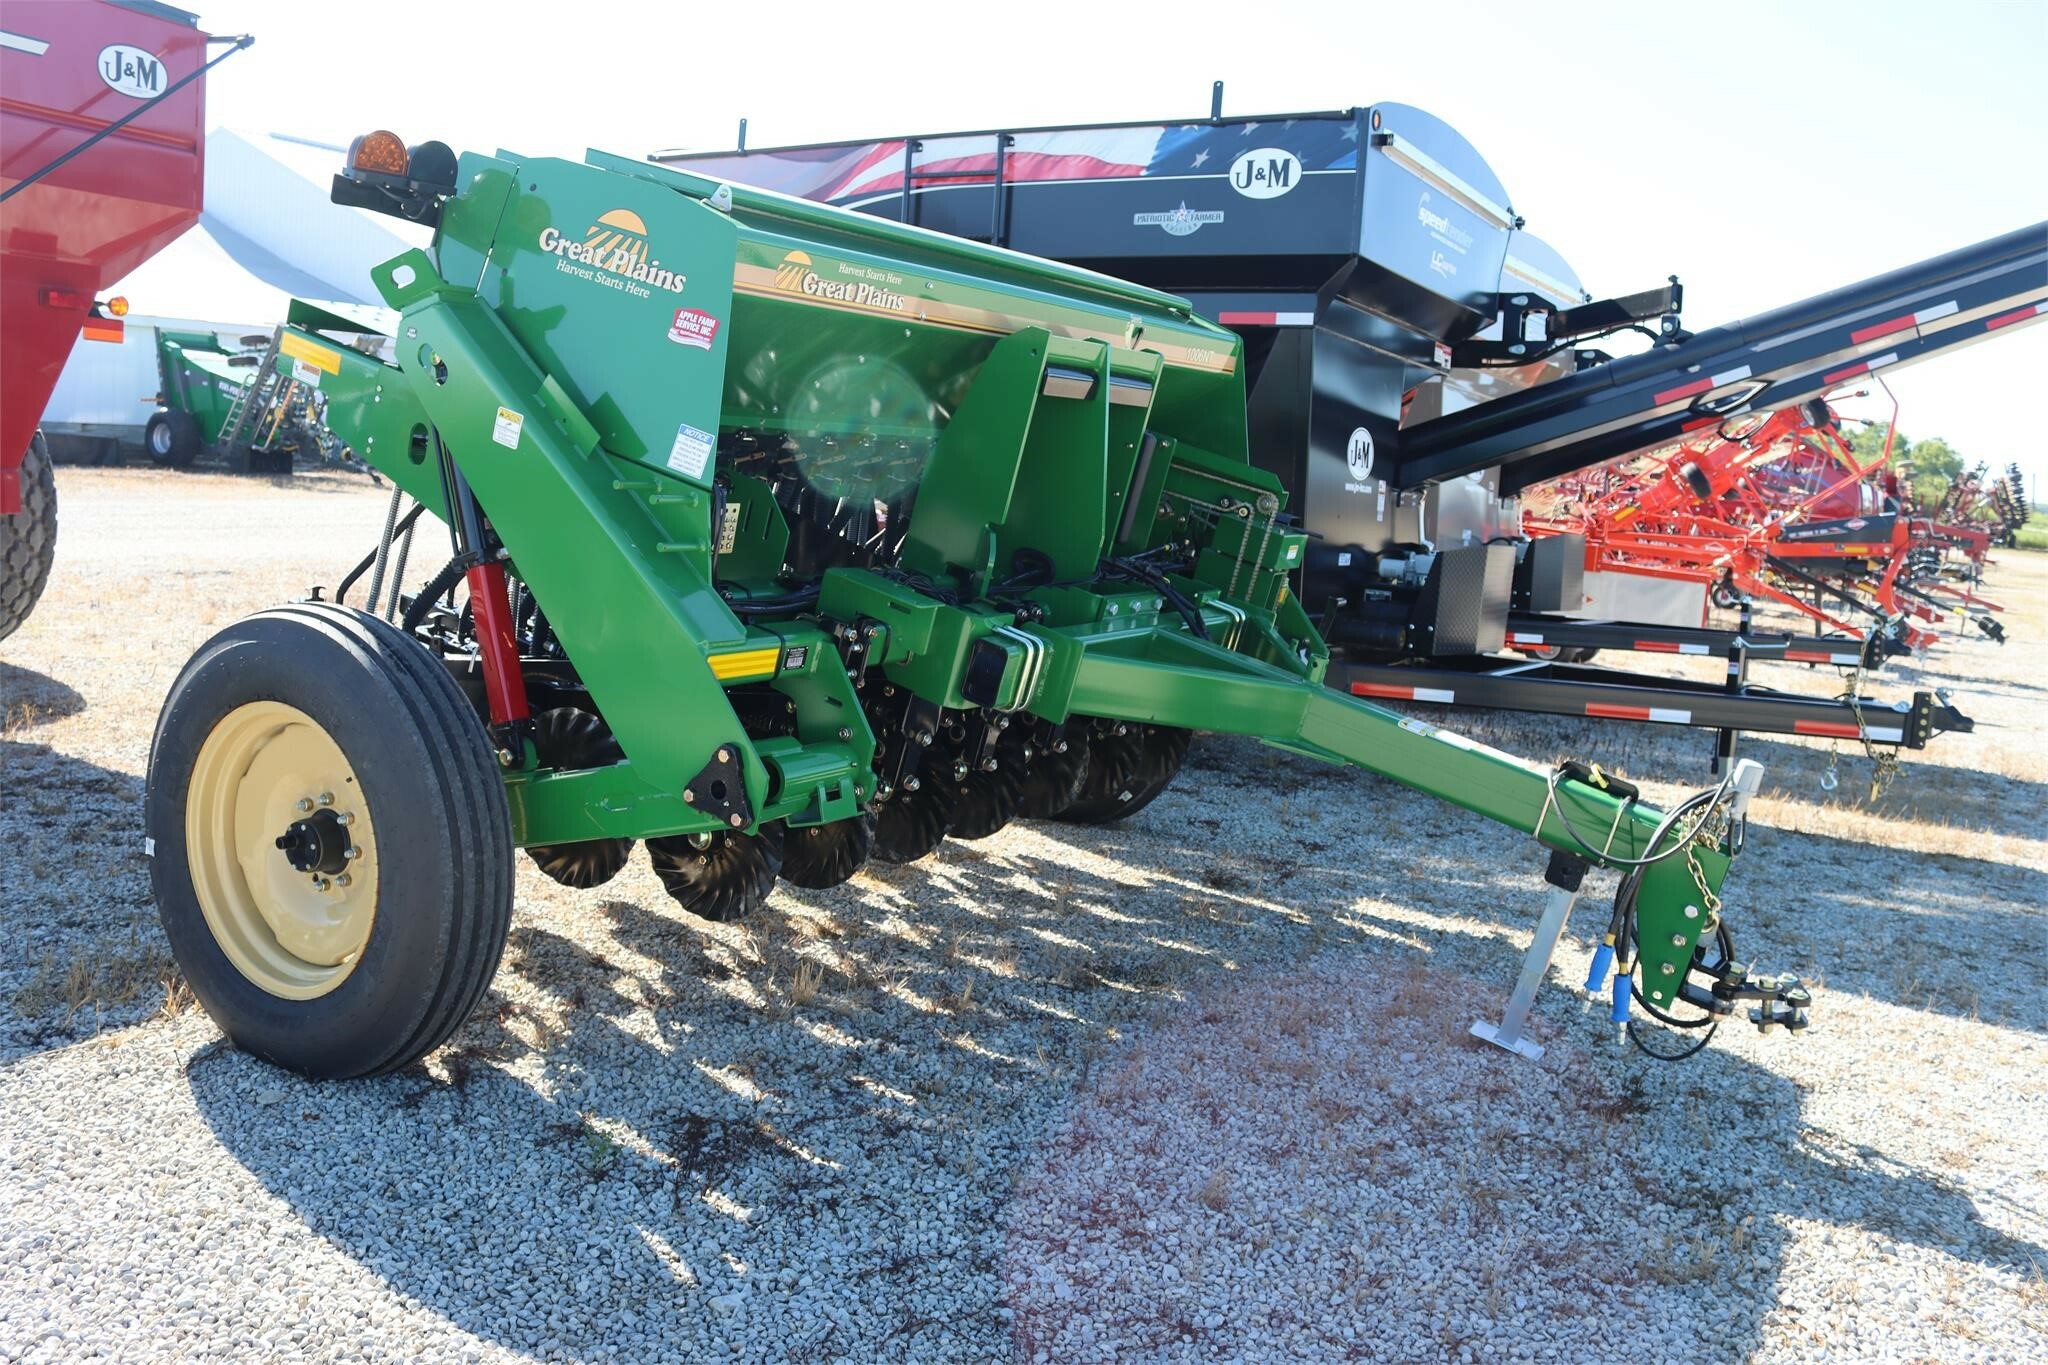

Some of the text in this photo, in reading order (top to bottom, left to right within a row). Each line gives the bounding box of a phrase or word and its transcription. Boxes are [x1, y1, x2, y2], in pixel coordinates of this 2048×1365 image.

[104, 50, 158, 92] J&M
[1235, 158, 1291, 189] J&M
[1136, 212, 1222, 224] PATRIOTIC FARMER
[538, 227, 687, 294] Great Plains
[838, 263, 903, 285] Harvest Starts Here
[556, 259, 651, 299] Harvest Starts Here
[802, 272, 905, 311] Great Plains
[675, 318, 700, 333] SERVICE
[679, 310, 716, 329] APPLE FARM
[683, 427, 711, 443] NOTICE
[1350, 439, 1371, 469] J&M
